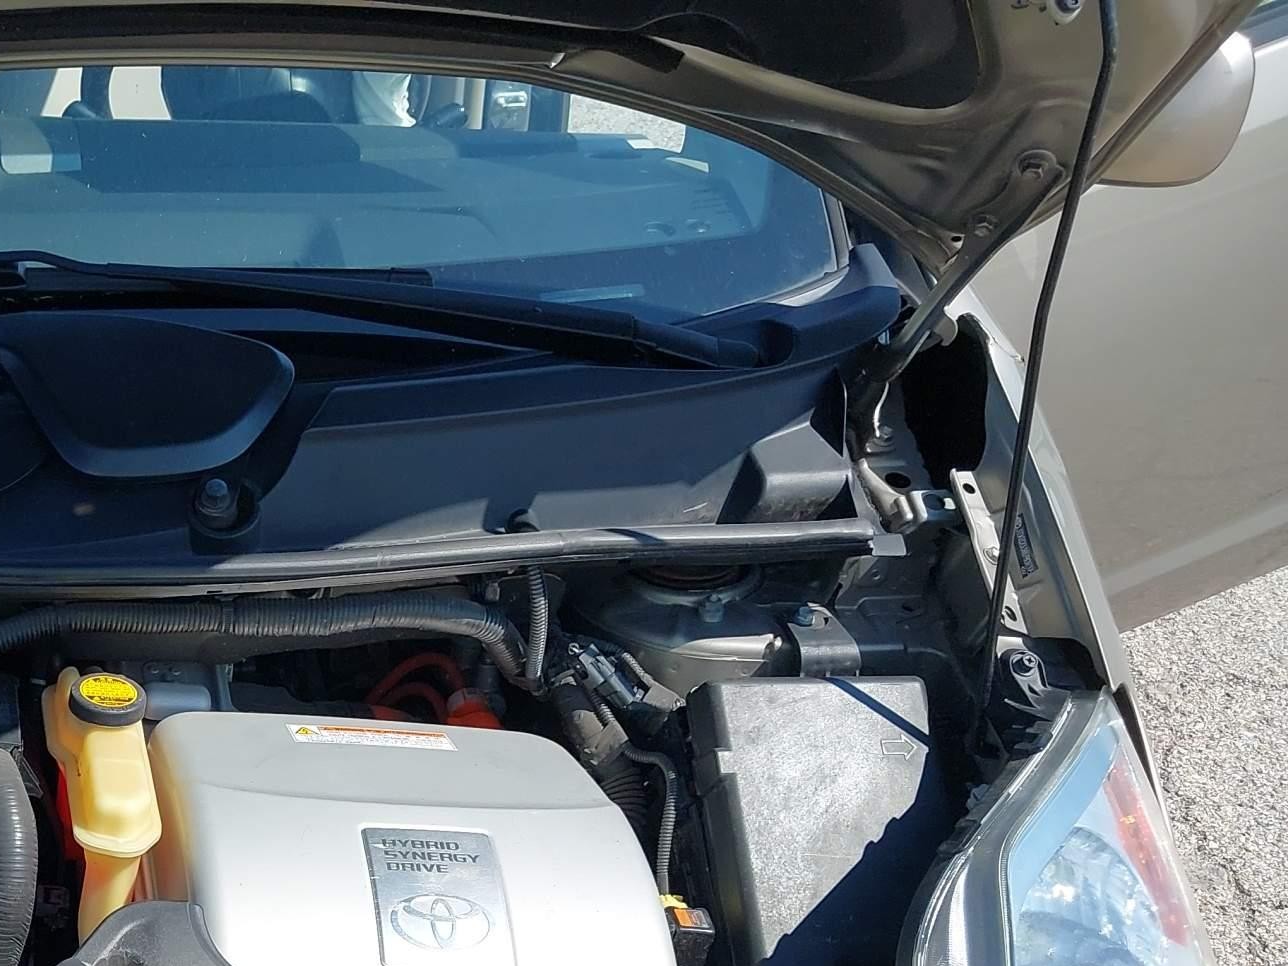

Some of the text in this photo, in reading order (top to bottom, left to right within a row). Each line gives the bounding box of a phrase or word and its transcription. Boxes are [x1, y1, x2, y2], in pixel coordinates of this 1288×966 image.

[381, 838, 460, 851] HYBRID
[383, 850, 481, 863] SYNERGY
[386, 862, 450, 873] DRIVE
